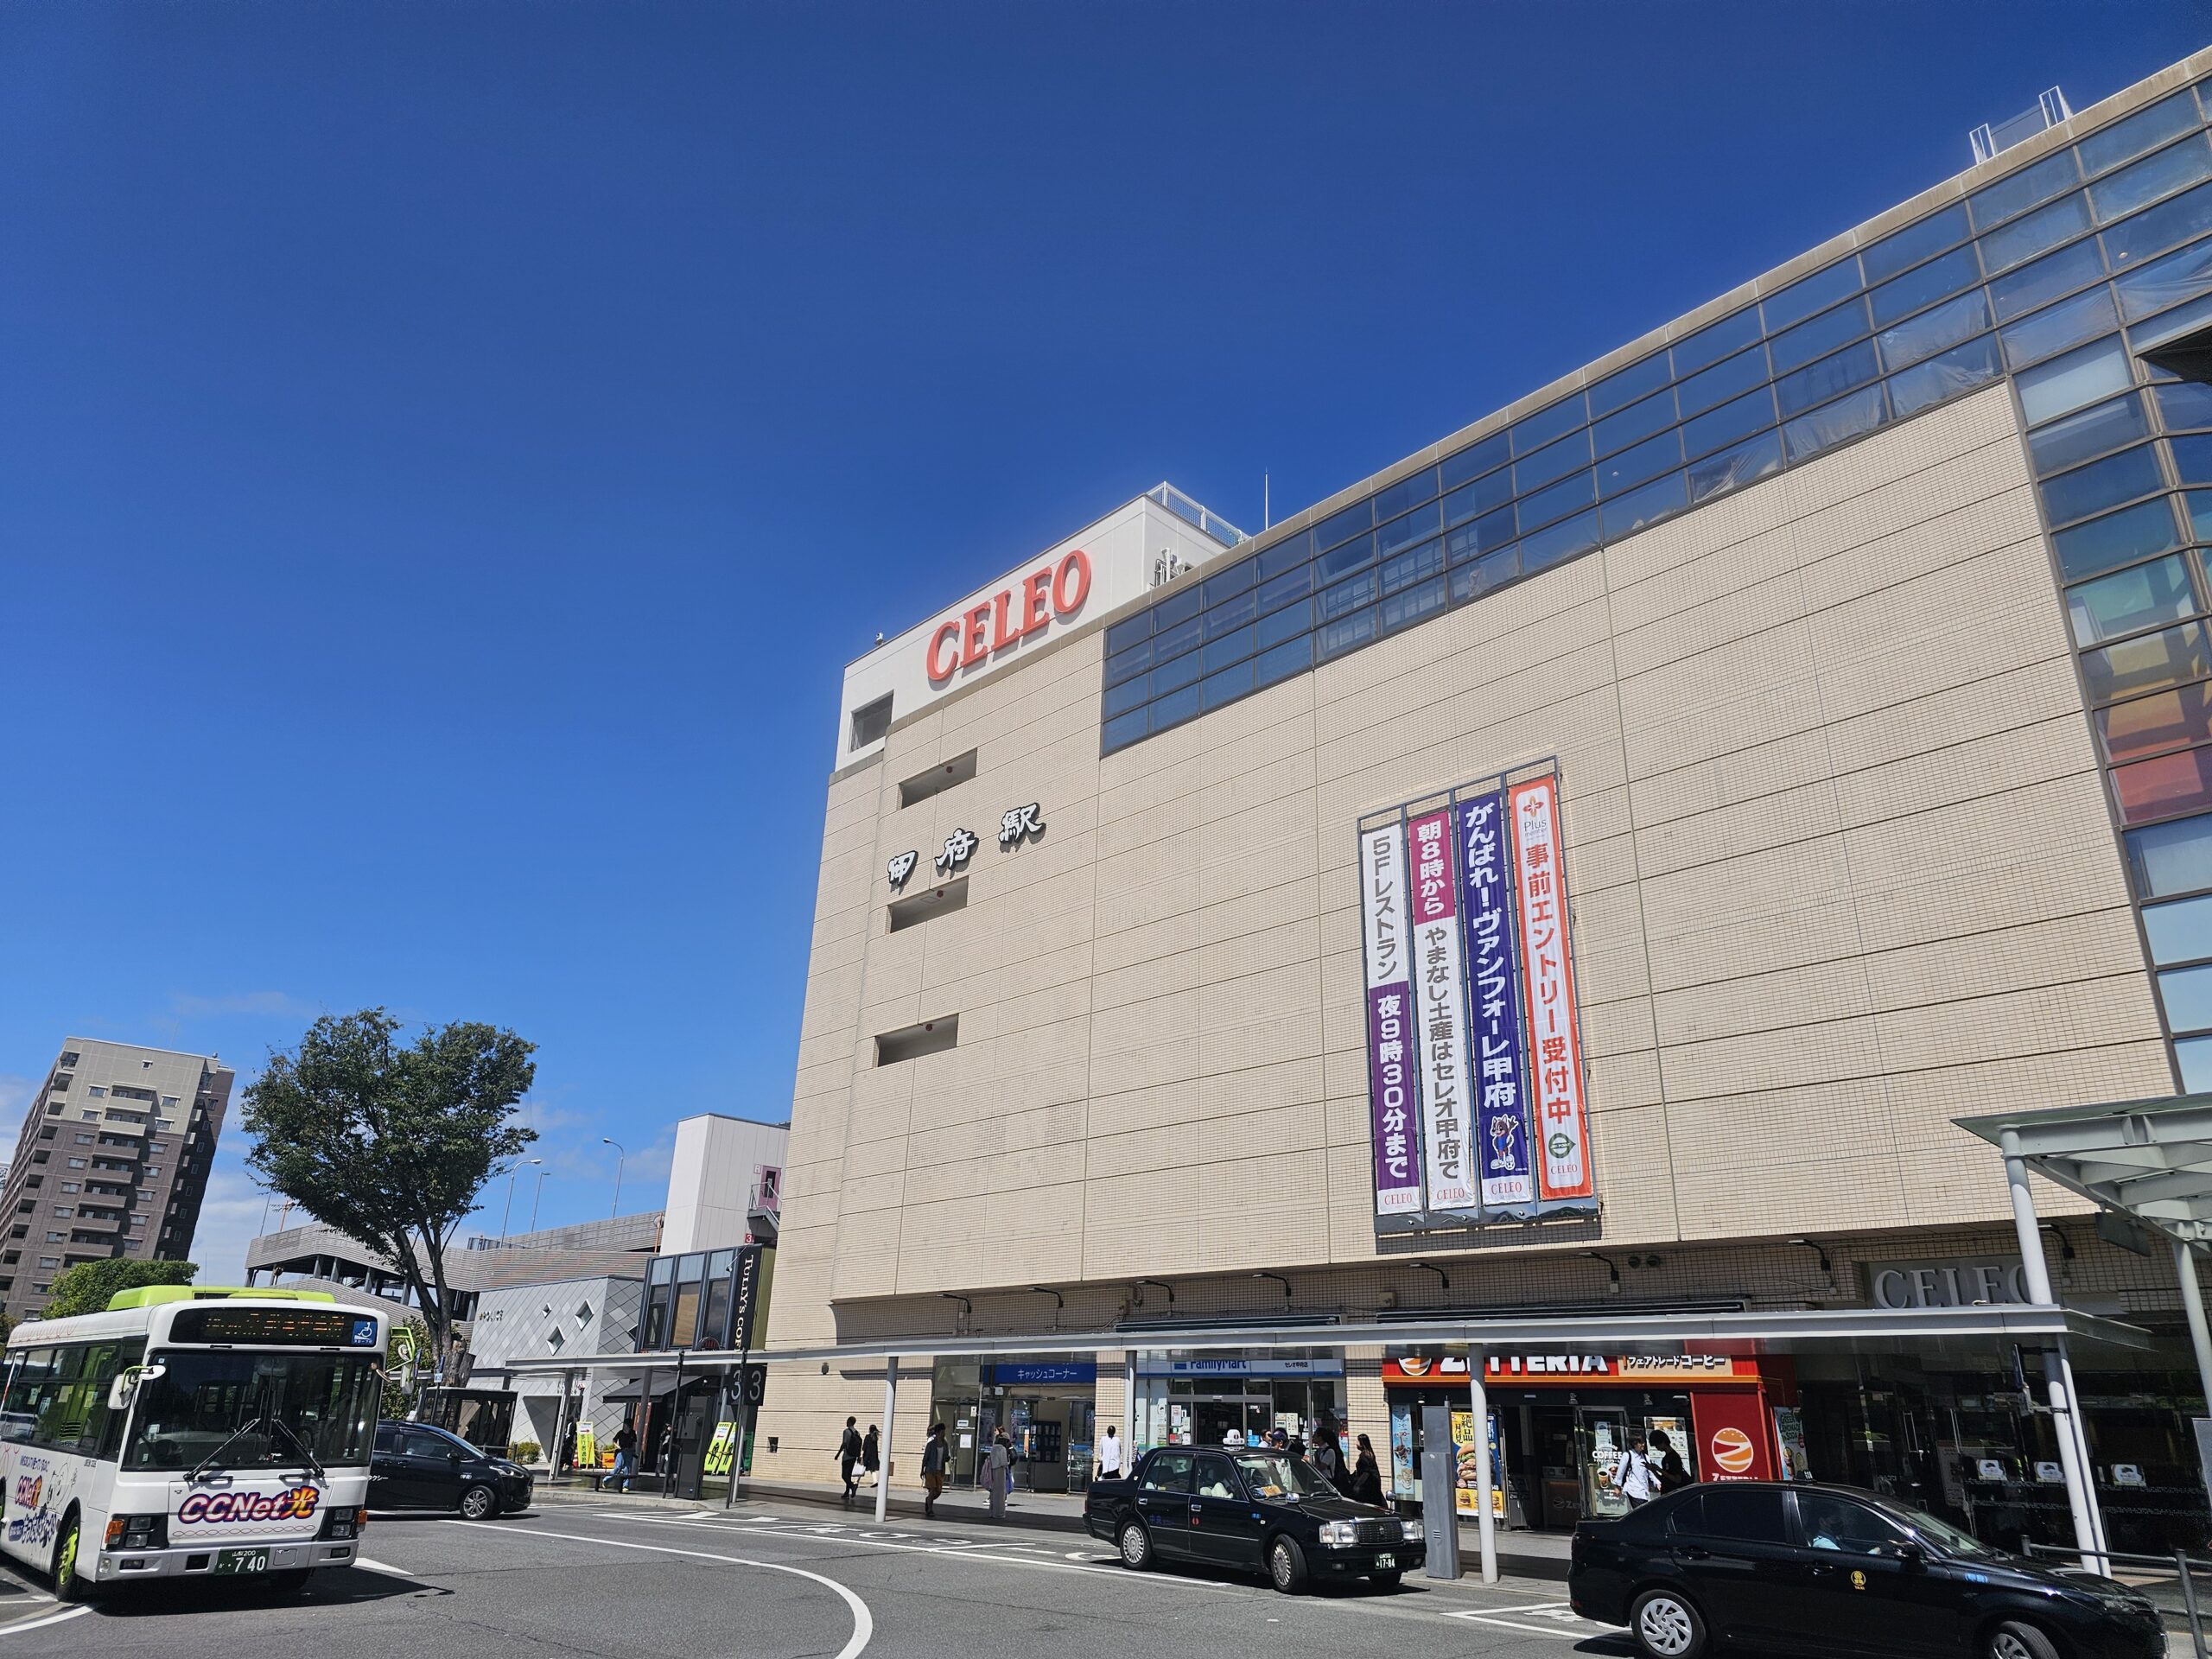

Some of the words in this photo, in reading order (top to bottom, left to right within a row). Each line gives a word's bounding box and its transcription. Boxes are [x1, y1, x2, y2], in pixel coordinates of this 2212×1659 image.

[926, 550, 1091, 682] CELEO
[1524, 820, 1547, 831] Plus
[888, 803, 1046, 884] 甲府駅
[1417, 820, 1446, 916] 朝8時から
[1373, 835, 1398, 981] 5Fレストラン
[1526, 843, 1572, 1124] 事前エントリー受付中
[1425, 926, 1460, 1179] やまなし土産はセレオ甲府で
[1378, 995, 1407, 1179] 夜9時30分まで
[1551, 1164, 1578, 1174] CELEO
[1385, 1193, 1412, 1205] CELEO
[1437, 1188, 1465, 1200] CELEO
[1491, 1182, 1522, 1195] CELEO
[1017, 1369, 1077, 1380] キャッシュコーナー
[1191, 1360, 1247, 1370] FamilyMart
[749, 1370, 761, 1401] 3
[1592, 1451, 1623, 1460] COFFEE
[178, 1486, 320, 1524] CCNet光
